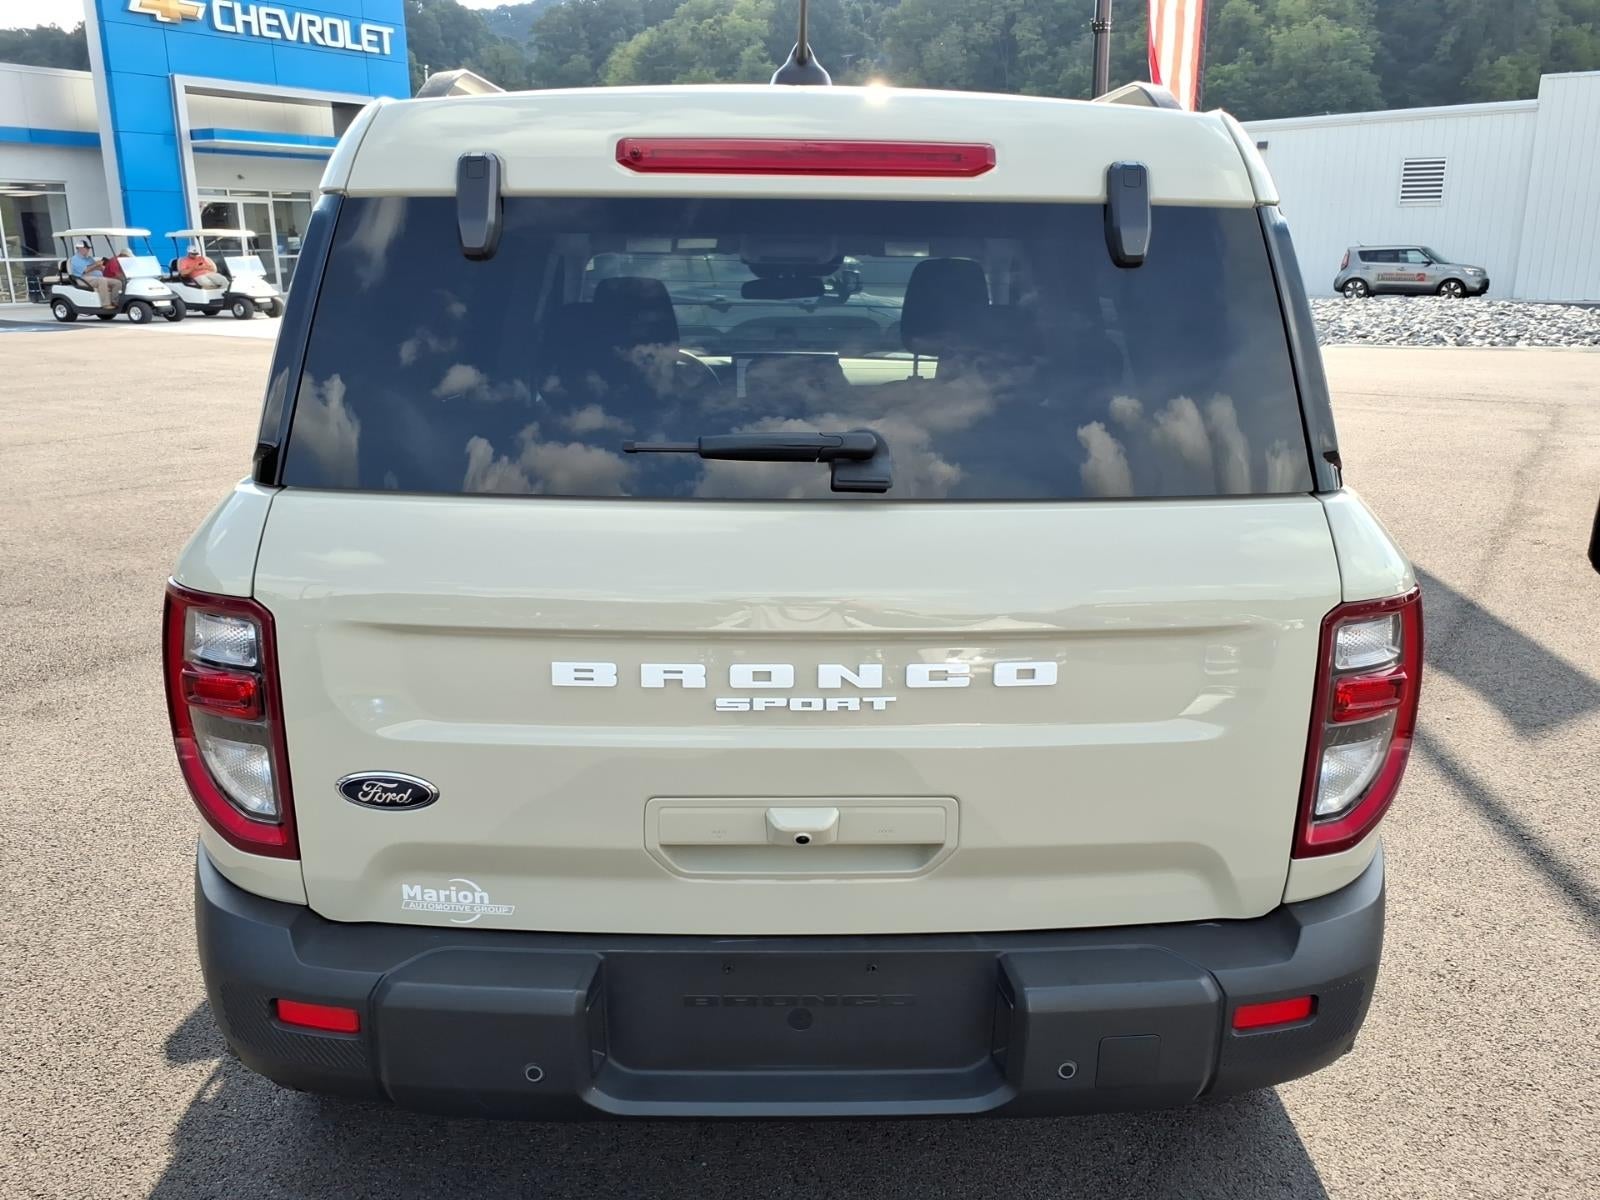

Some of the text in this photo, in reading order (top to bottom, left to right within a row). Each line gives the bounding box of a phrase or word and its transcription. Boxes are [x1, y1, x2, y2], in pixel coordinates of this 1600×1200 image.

[211, 0, 395, 56] CHEVROLET
[551, 661, 1058, 688] BRONCO
[714, 696, 897, 712] SPORT
[357, 780, 412, 804] Ford
[401, 884, 490, 905] Marion
[408, 901, 511, 914] AUTOMOTIVE GROUP
